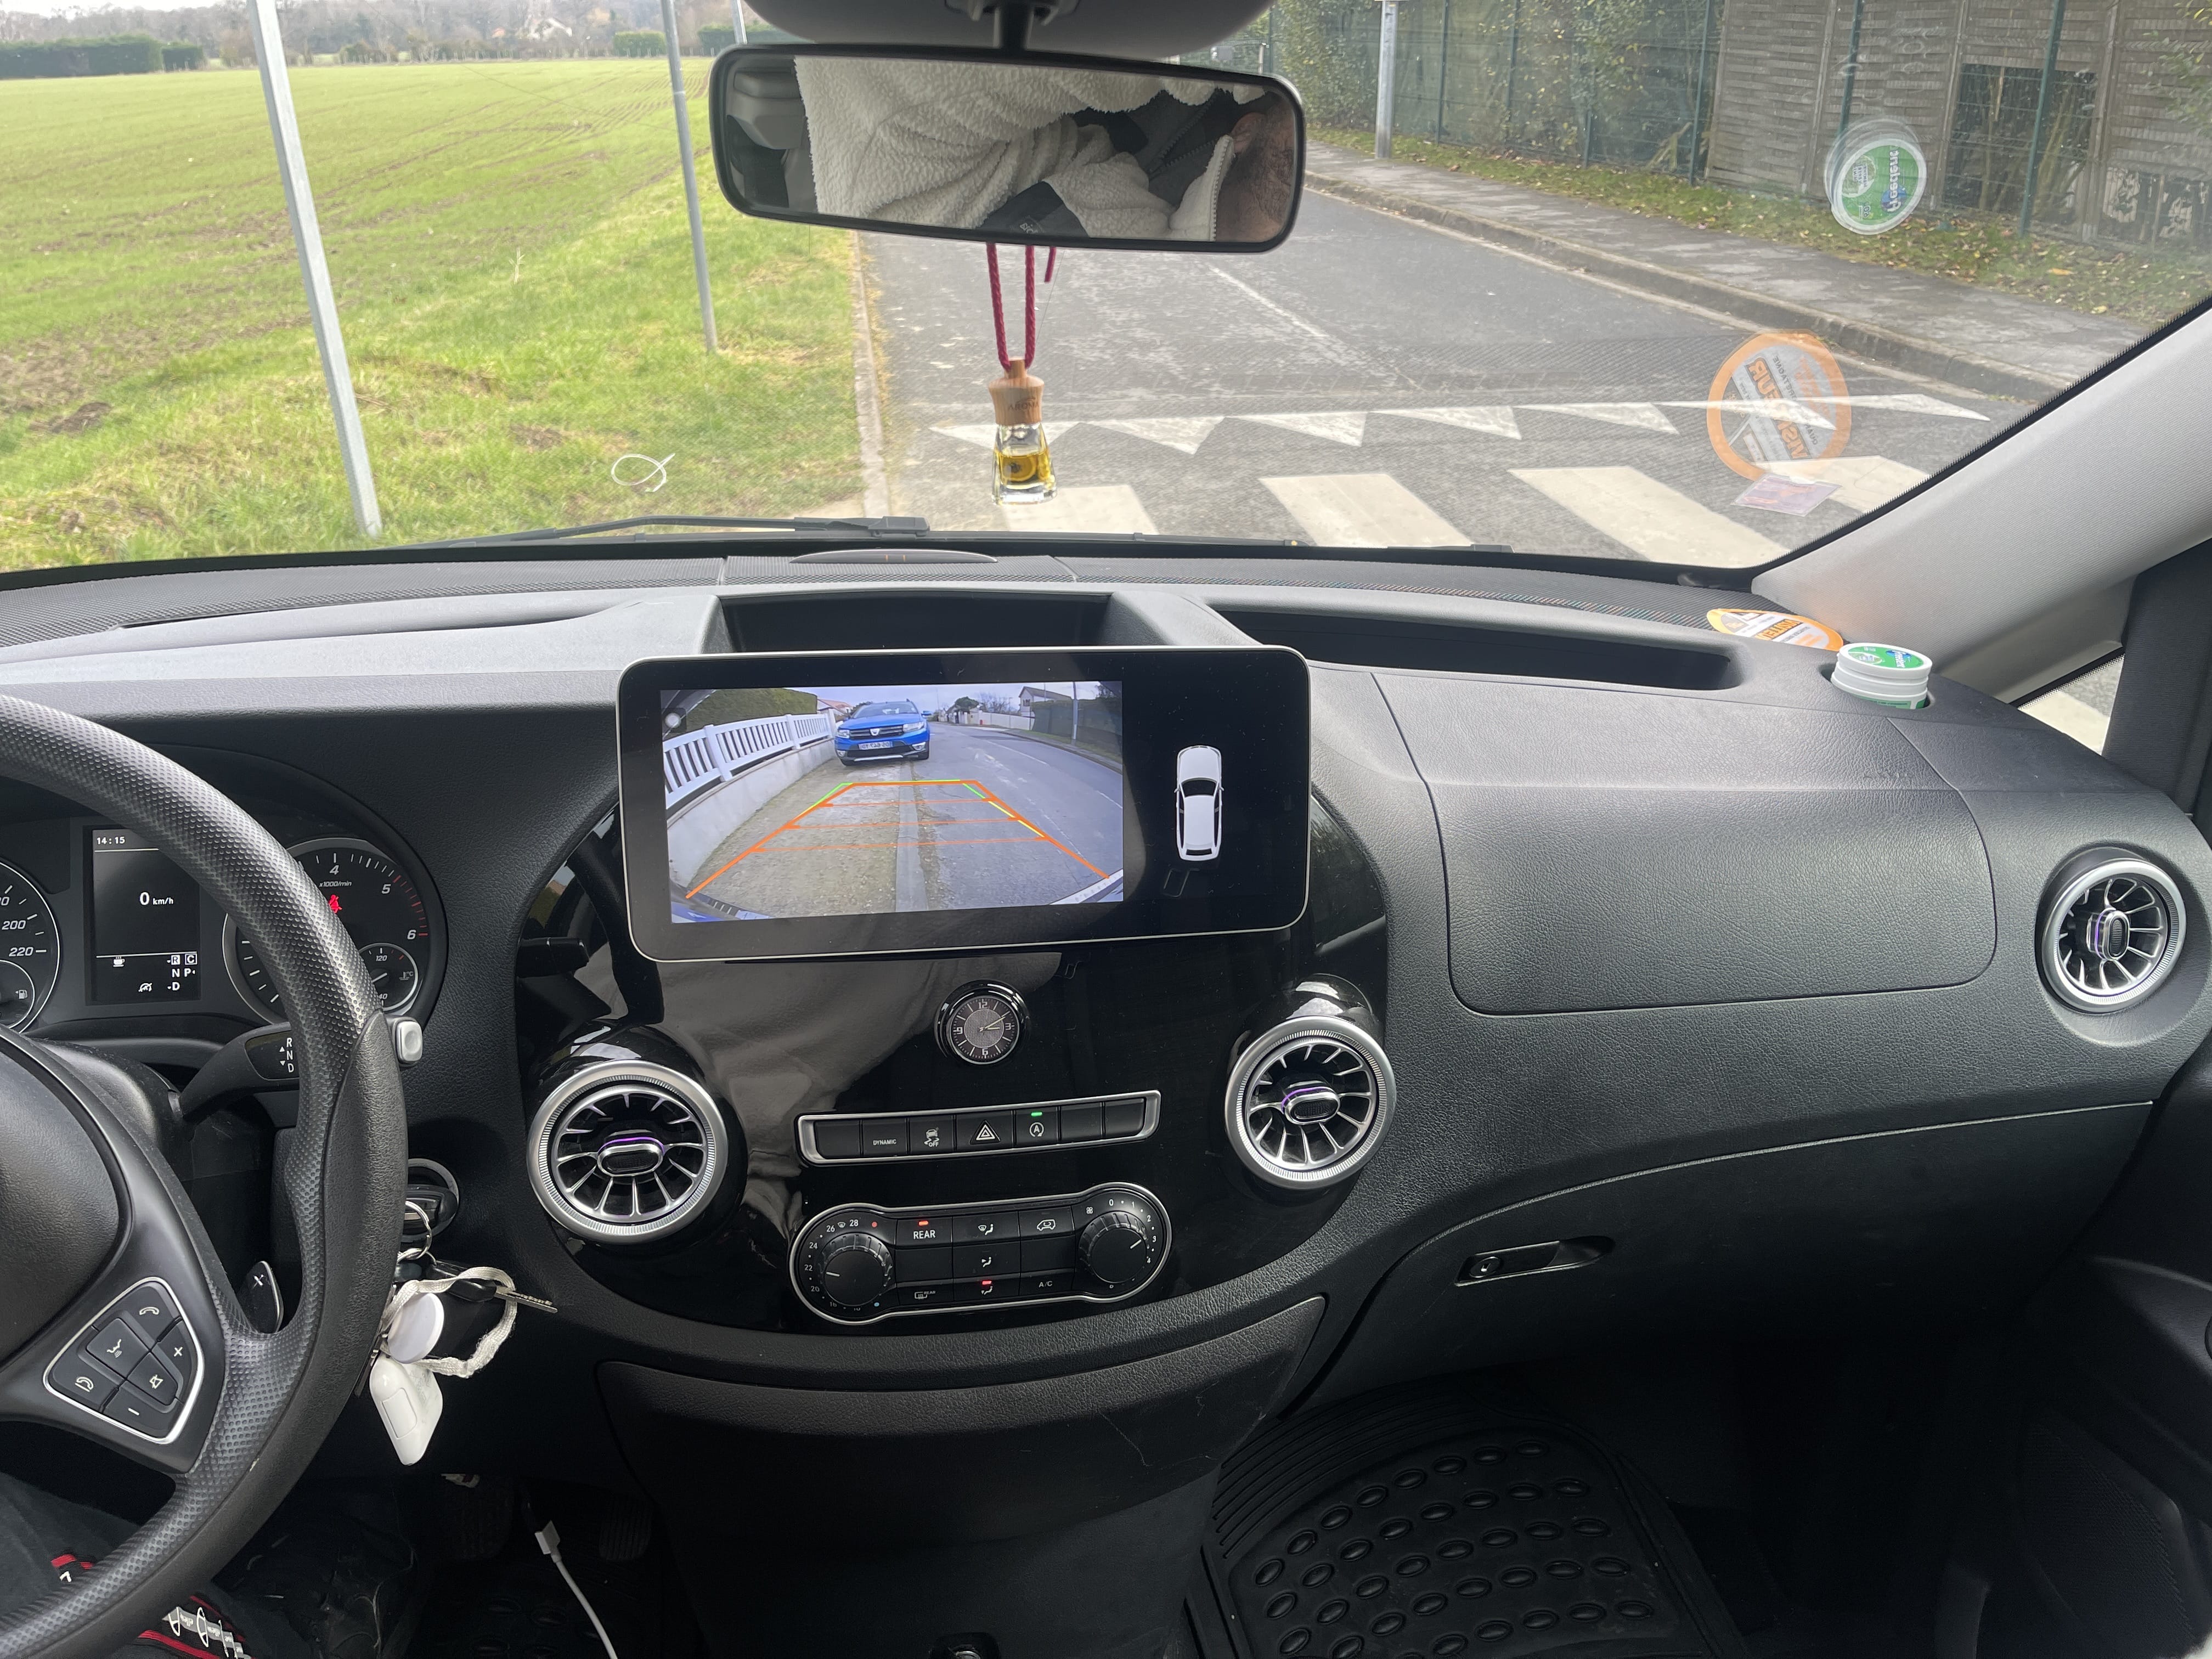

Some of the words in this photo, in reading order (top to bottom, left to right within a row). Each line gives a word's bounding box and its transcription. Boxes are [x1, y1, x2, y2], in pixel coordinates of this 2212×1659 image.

[97, 836, 126, 845] 14:15
[329, 865, 339, 874] 4
[381, 884, 391, 894] 5
[139, 891, 150, 905] 0
[2, 920, 26, 930] 200
[407, 929, 416, 940] 6
[9, 947, 33, 957] 220
[172, 968, 180, 978] N
[184, 968, 191, 977] P
[172, 981, 180, 991] D
[956, 1026, 963, 1035] 9
[286, 1037, 292, 1047] R
[286, 1050, 293, 1060] N
[287, 1063, 294, 1073] D
[913, 1229, 936, 1240] REAR
